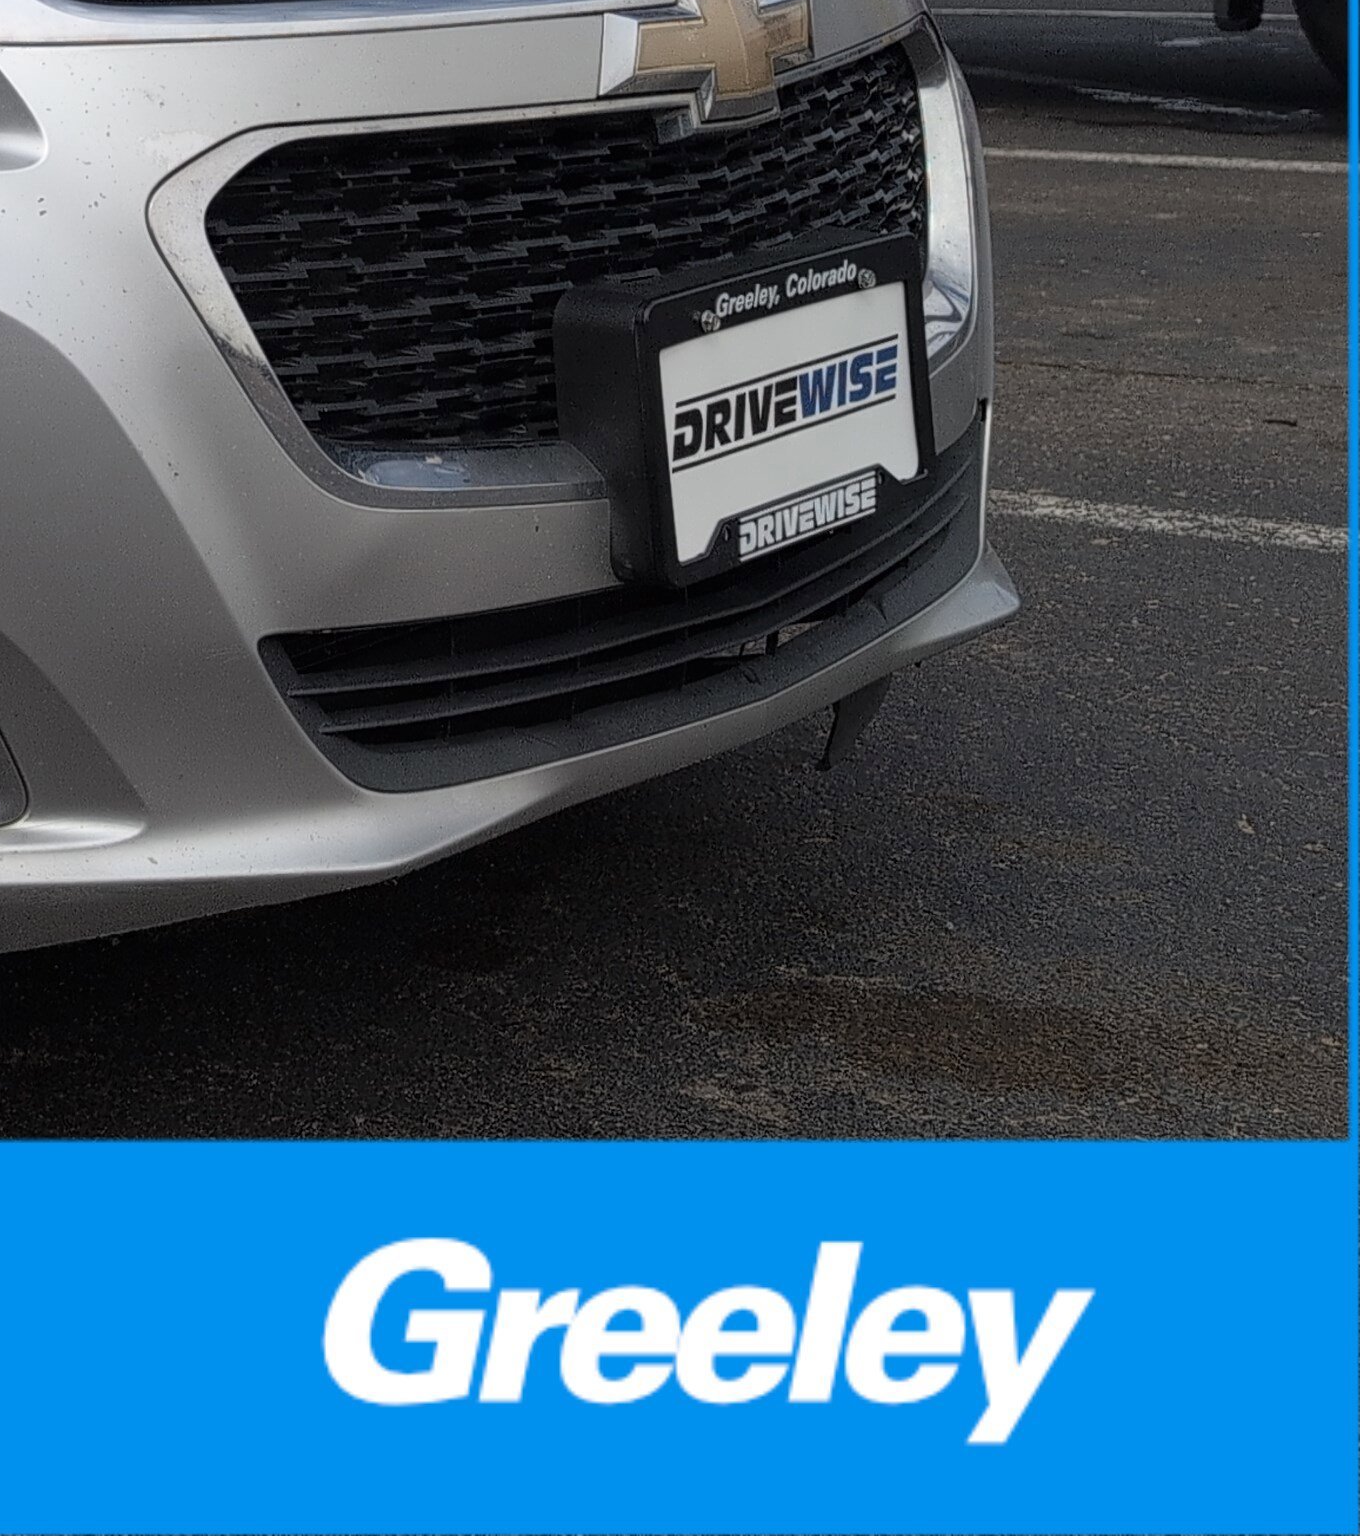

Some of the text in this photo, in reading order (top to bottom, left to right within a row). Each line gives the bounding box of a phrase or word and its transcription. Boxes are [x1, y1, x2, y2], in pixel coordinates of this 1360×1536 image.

[716, 259, 857, 318] Greeley, Colorado
[672, 344, 899, 462] DRIVEWISE
[739, 476, 877, 556] DRIVEWISE
